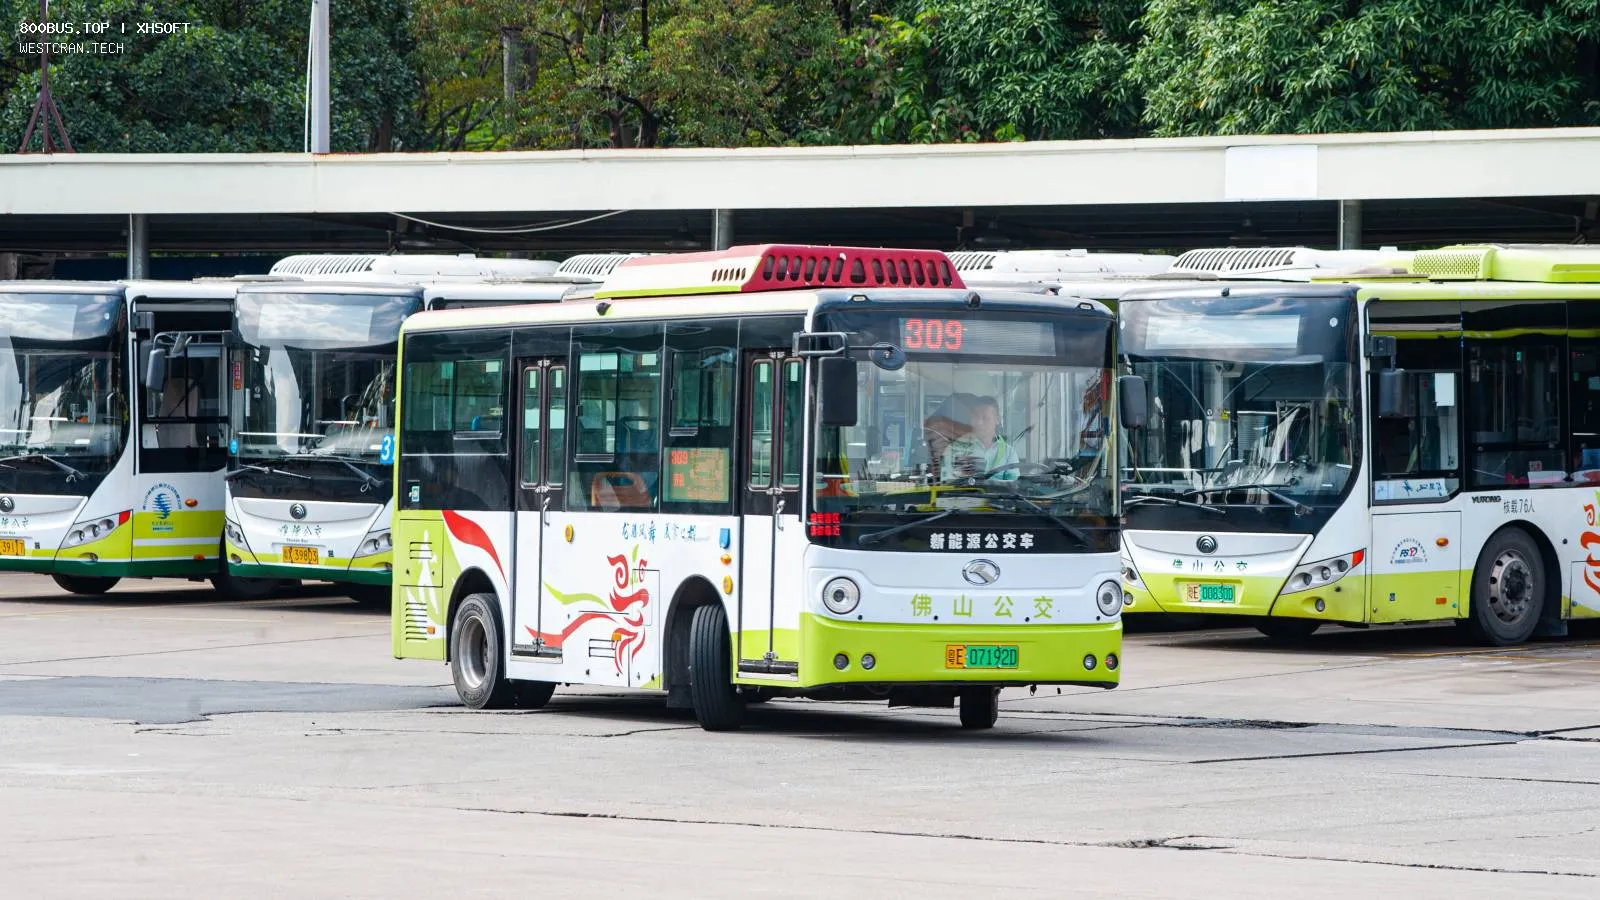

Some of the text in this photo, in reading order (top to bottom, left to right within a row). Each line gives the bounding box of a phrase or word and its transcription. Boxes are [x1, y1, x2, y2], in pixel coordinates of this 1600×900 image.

[905, 319, 963, 350] 309
[381, 435, 395, 461] 3
[929, 532, 1035, 550] 新能源公交车
[910, 593, 1054, 619] 佛山公交
